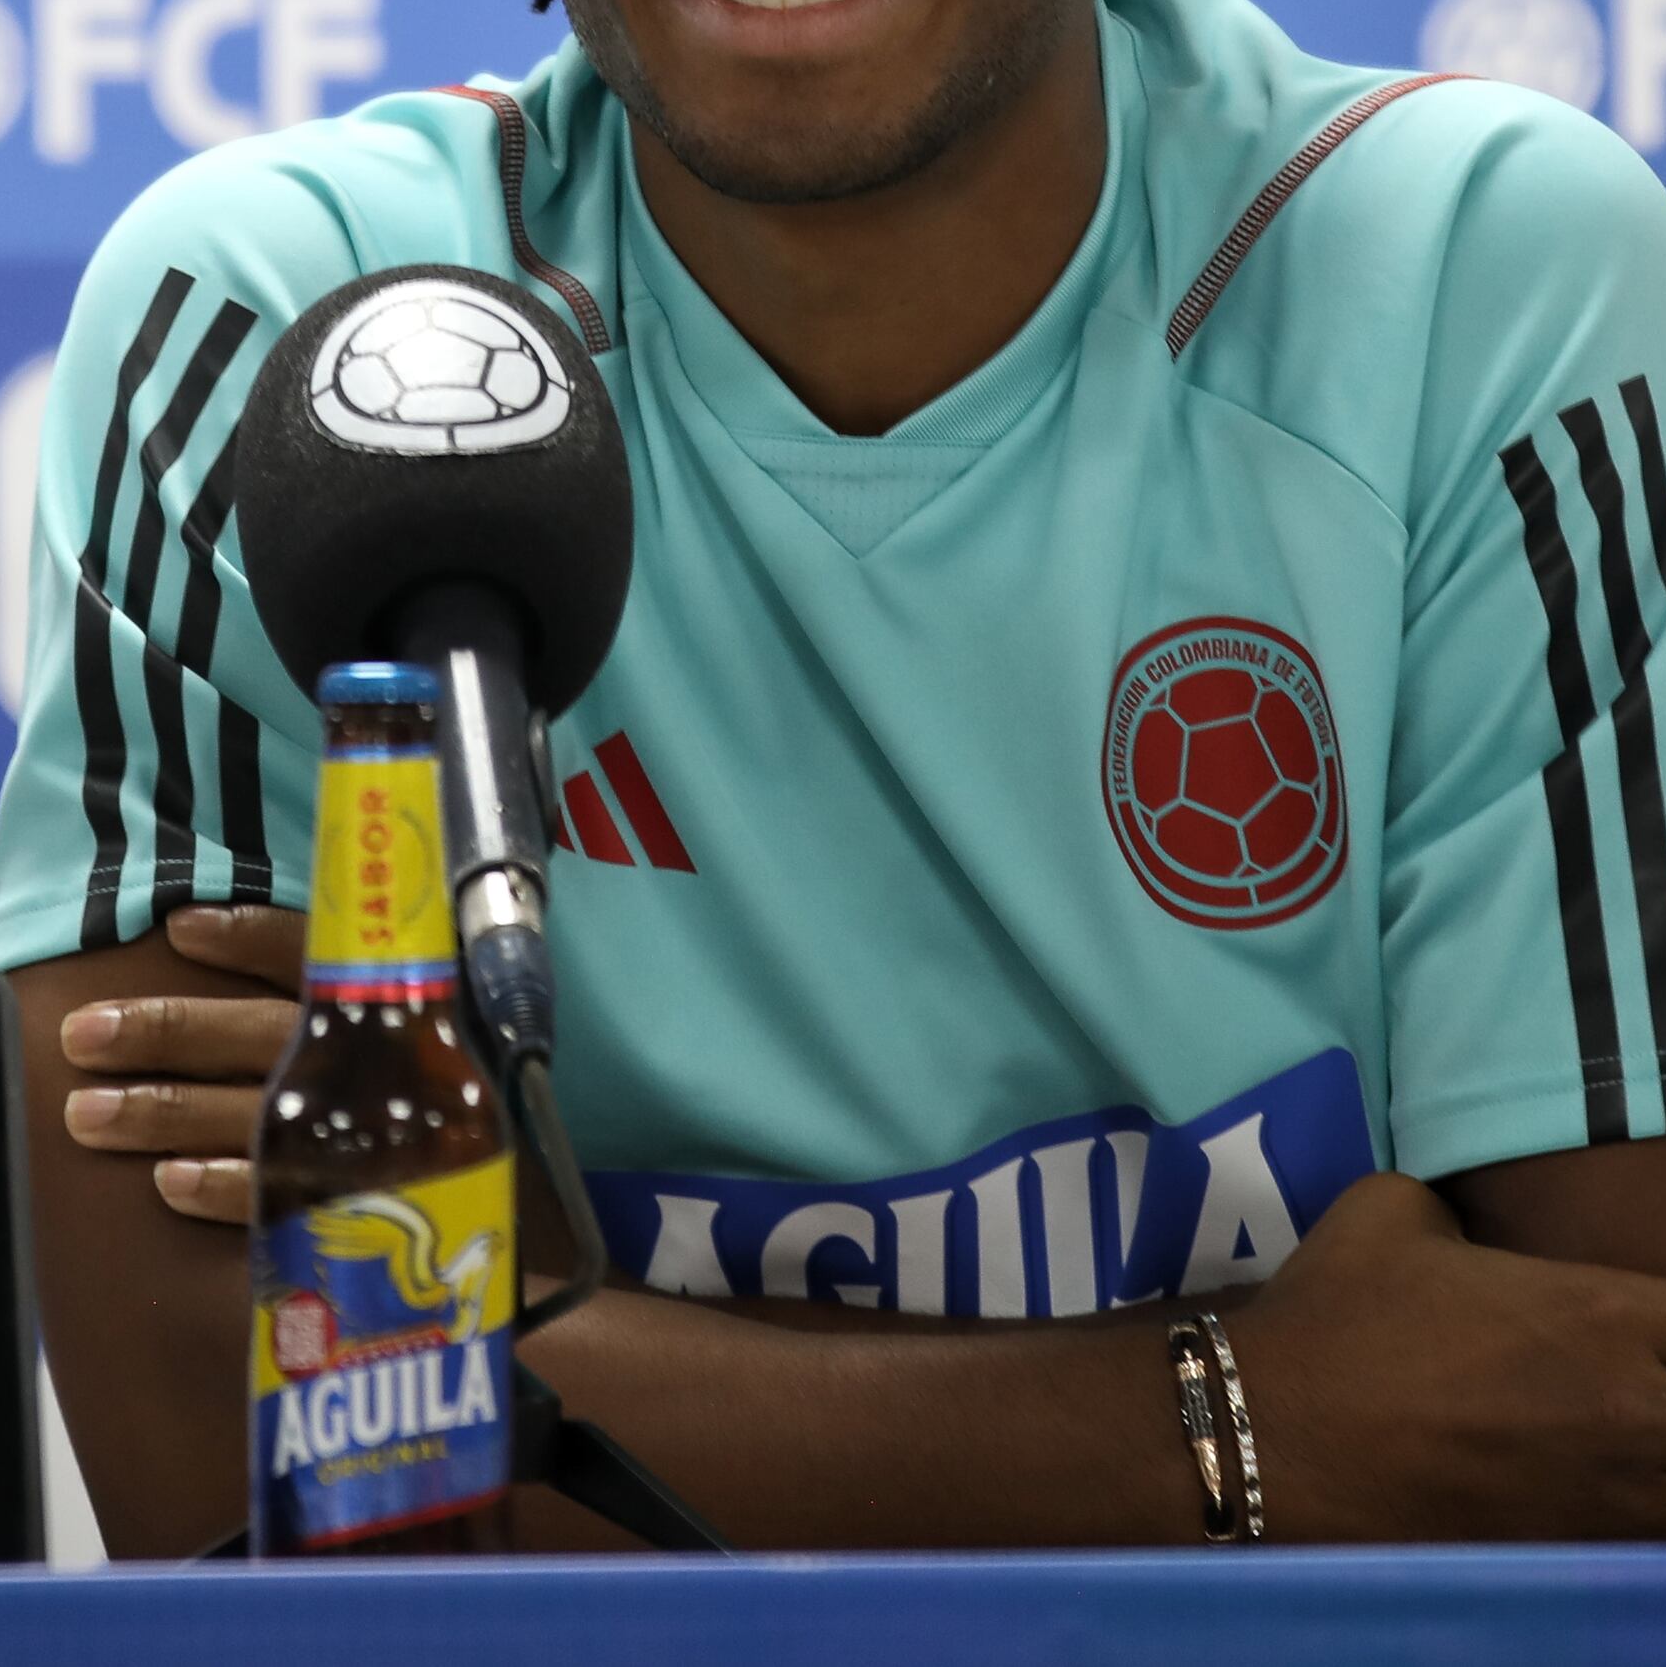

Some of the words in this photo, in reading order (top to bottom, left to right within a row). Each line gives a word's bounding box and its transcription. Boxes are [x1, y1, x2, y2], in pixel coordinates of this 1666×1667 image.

[1144, 638, 1270, 684] COLOMBIANA
[1273, 654, 1298, 683] DE
[271, 1338, 497, 1479] AGUILA
